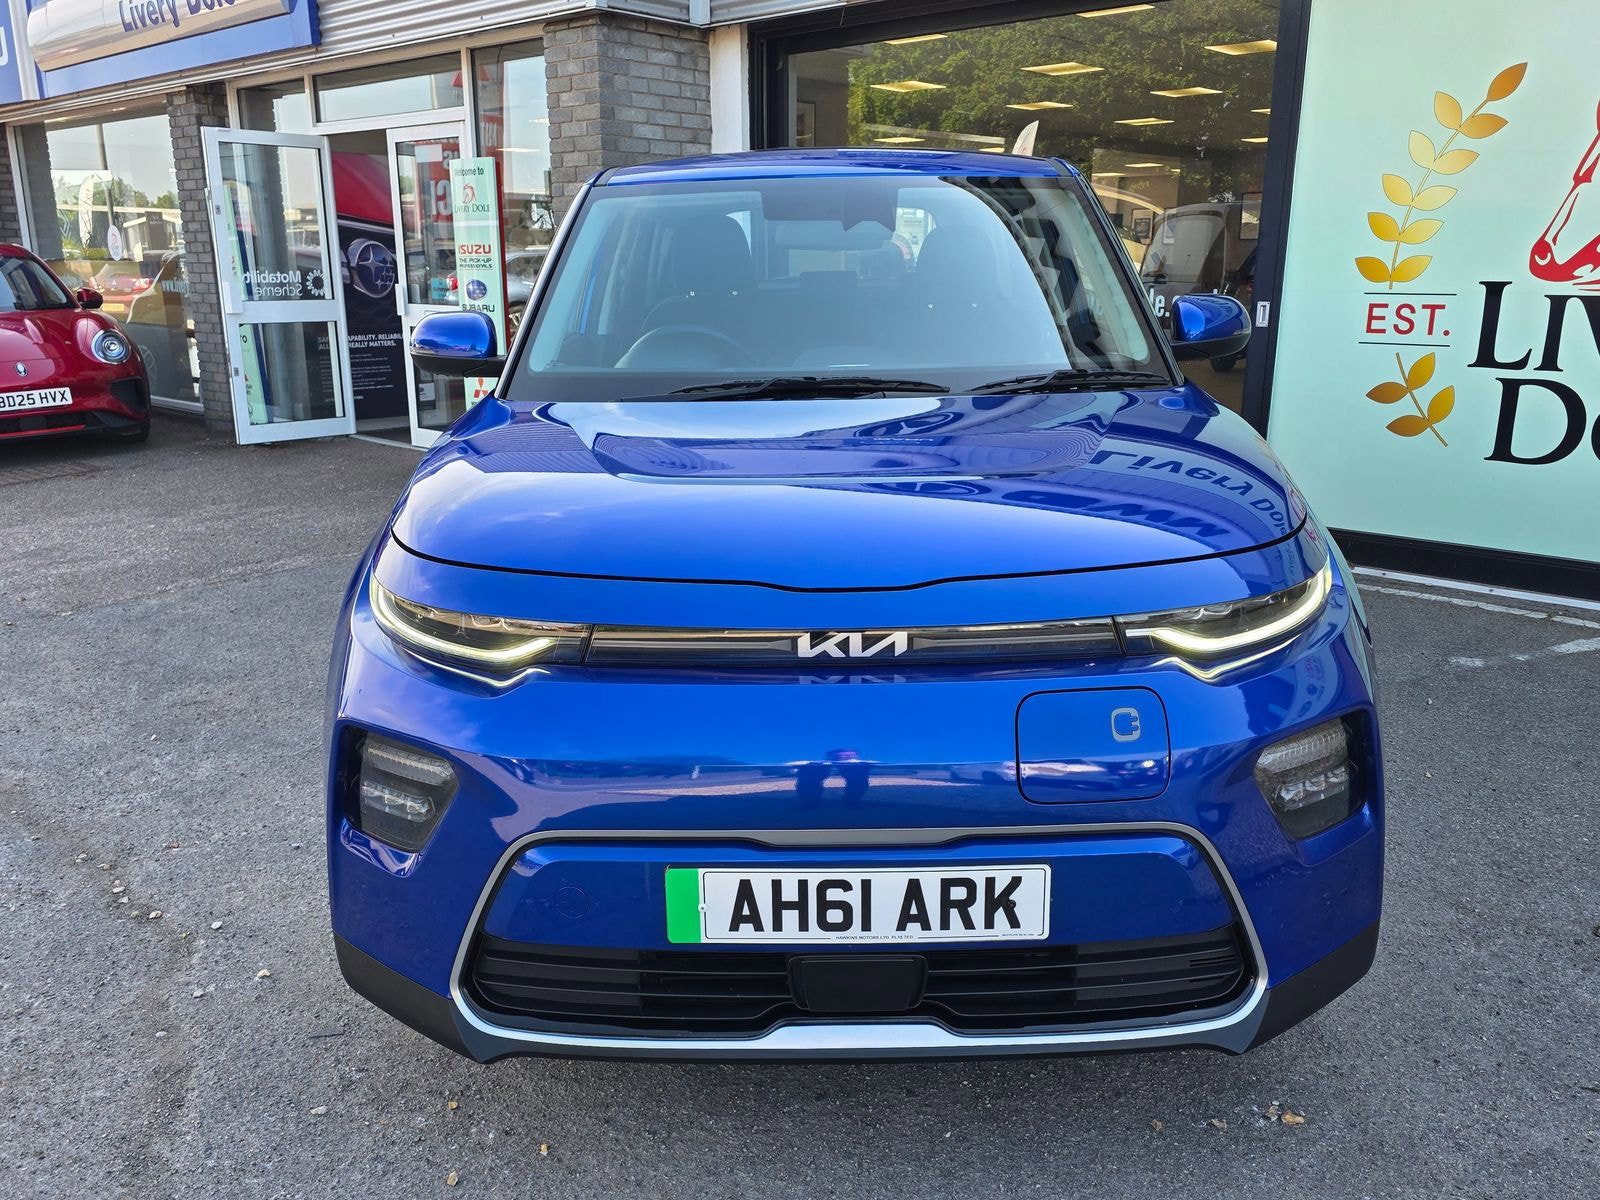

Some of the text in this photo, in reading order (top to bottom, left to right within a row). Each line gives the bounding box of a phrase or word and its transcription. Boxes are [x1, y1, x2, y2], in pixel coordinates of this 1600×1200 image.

[119, 0, 181, 33] Livery
[458, 244, 491, 255] ISUZU
[461, 303, 496, 312] SUBARU
[1365, 303, 1450, 336] EST.
[39, 390, 68, 404] HVX
[797, 631, 908, 658] KIA
[728, 875, 1023, 932] AH61 ARK
